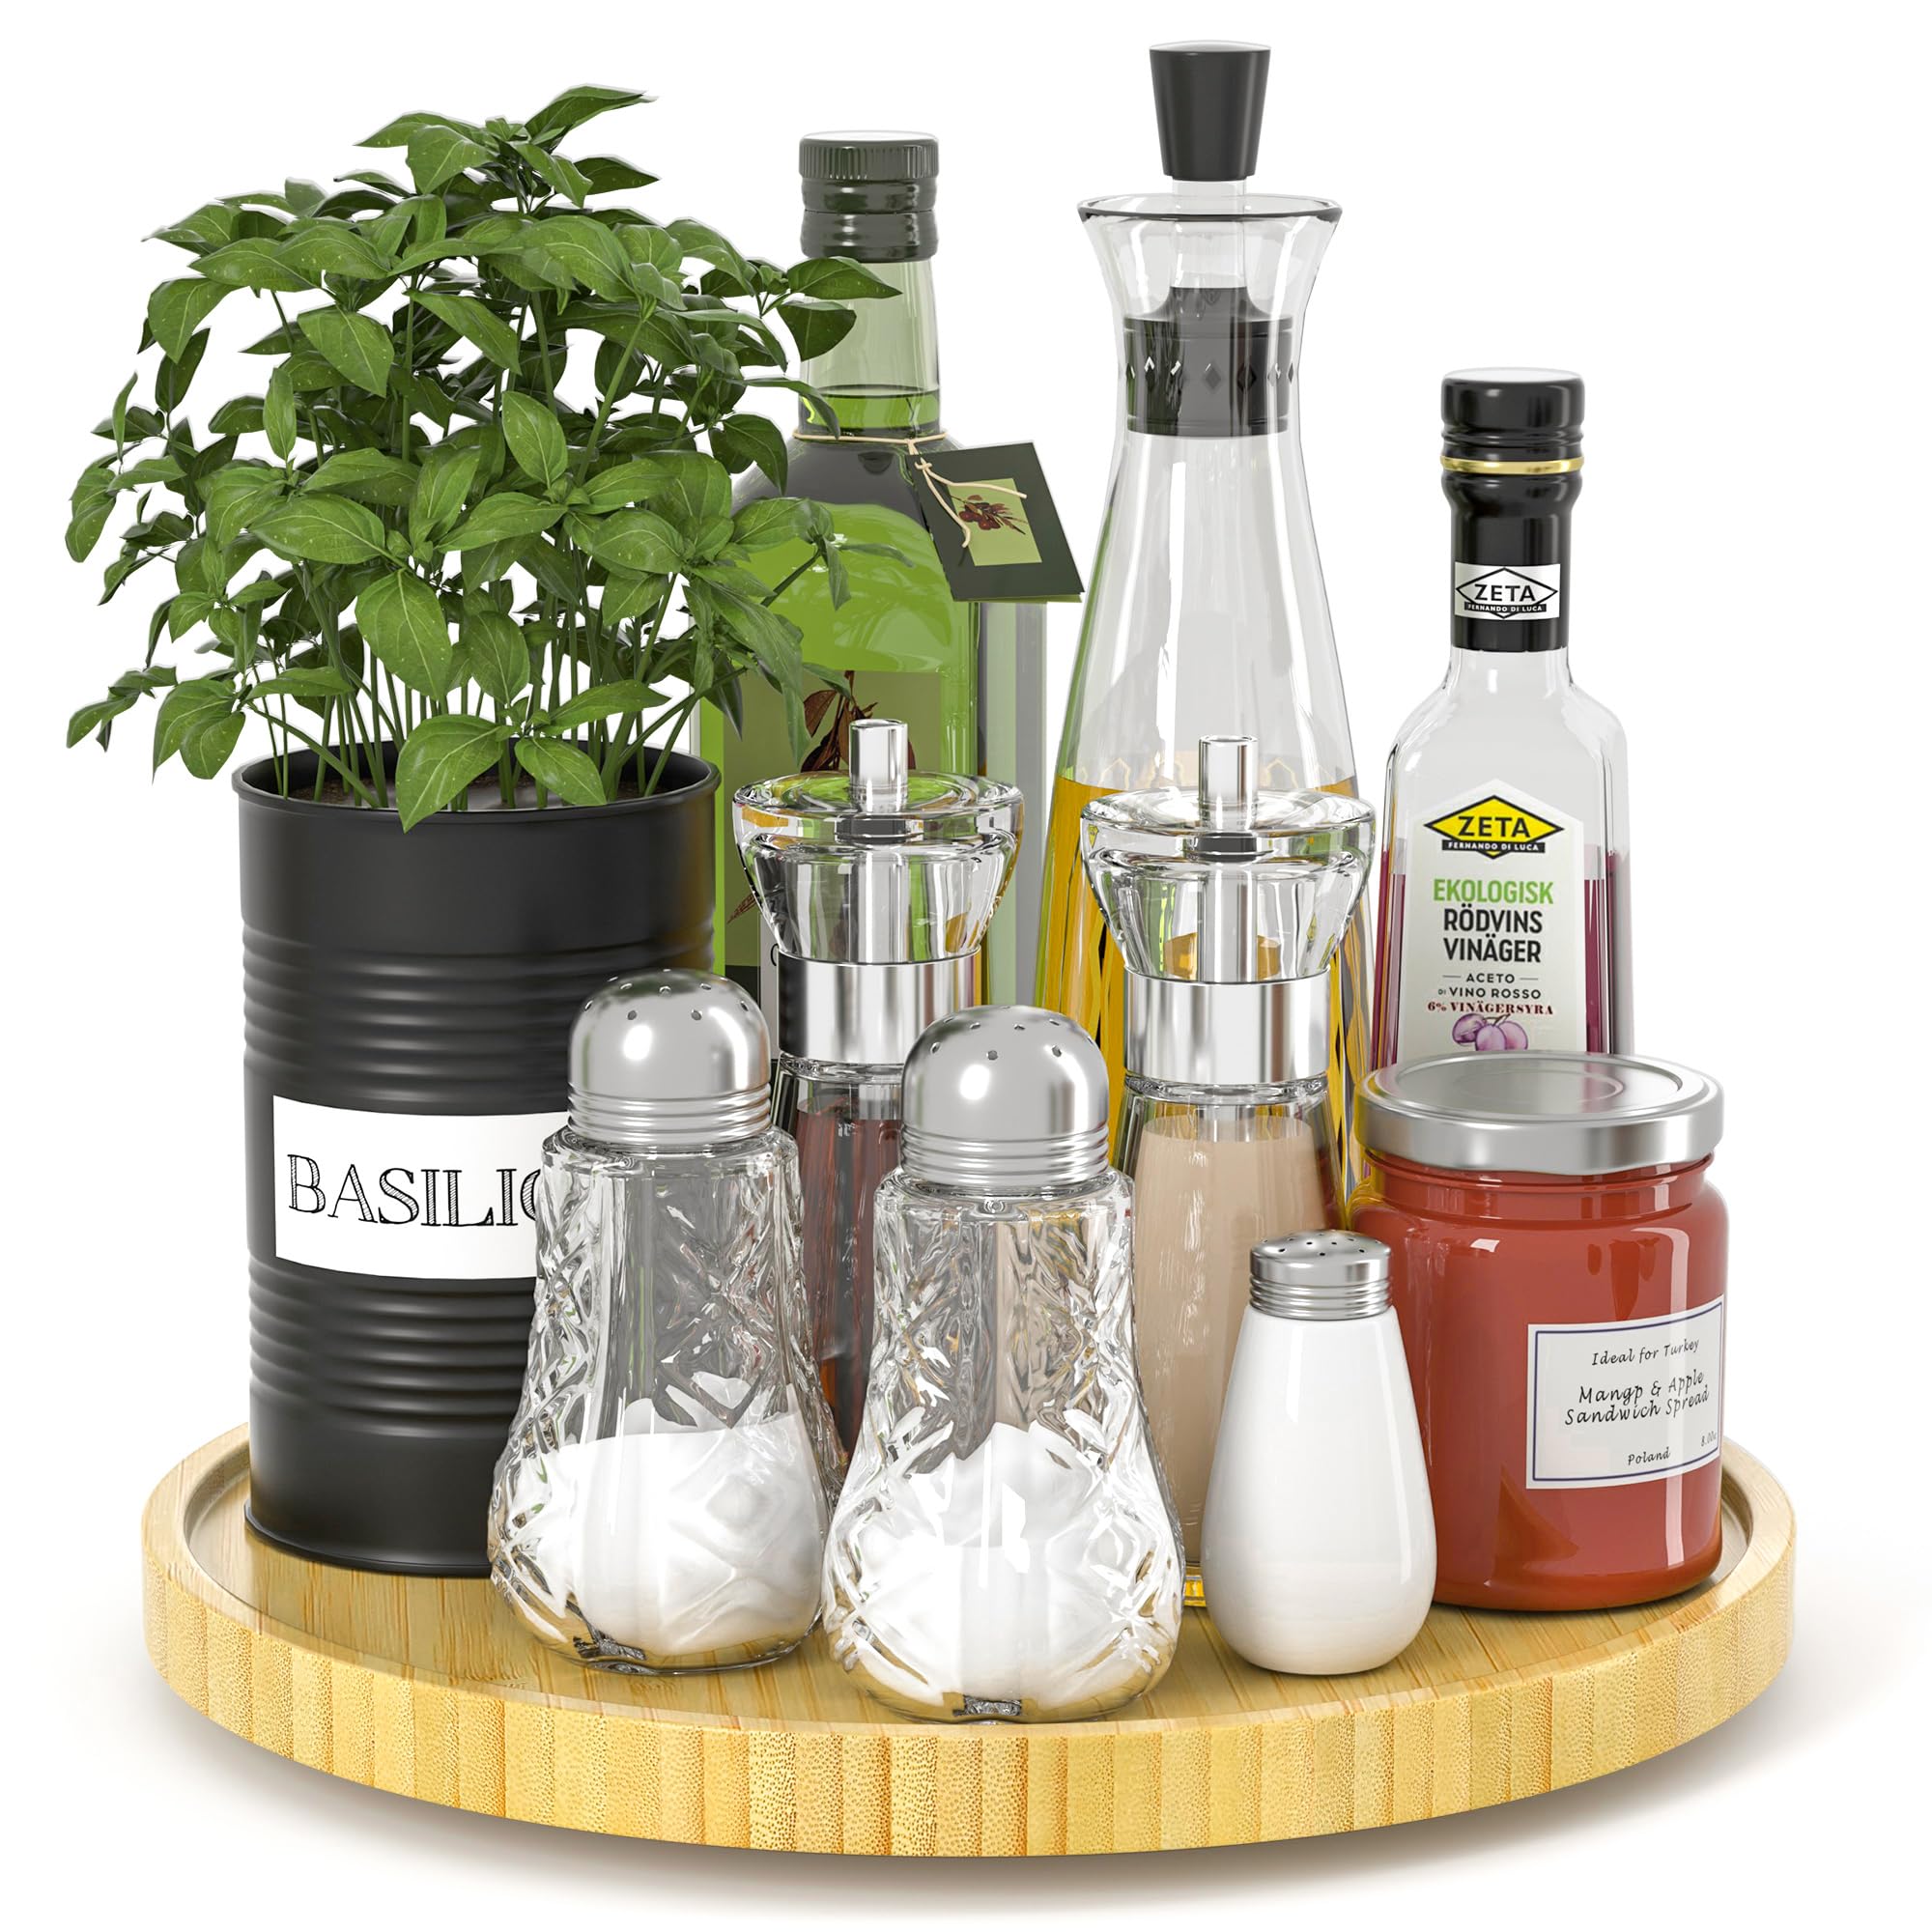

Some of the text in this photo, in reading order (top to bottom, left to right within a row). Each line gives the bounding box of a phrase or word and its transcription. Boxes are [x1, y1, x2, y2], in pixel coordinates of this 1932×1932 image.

[1474, 583, 1536, 602] ZETA
[1468, 604, 1508, 612] FERNANDO
[1458, 815, 1530, 838] ZETA
[1448, 841, 1498, 850] FERNANDO
[1433, 878, 1554, 904] EKOLOGISK
[1443, 903, 1543, 934] RÖDVINS
[1443, 933, 1542, 963] VINÄGER
[1465, 973, 1516, 984] ACETO
[1449, 986, 1487, 998] VINO
[1491, 988, 1542, 1000] ROSSO
[1427, 1000, 1554, 1014] 6% VINÄGERSYRA
[1591, 1338, 1700, 1366] Ideal for Turkey
[1650, 1380, 1662, 1398] &
[1667, 1368, 1705, 1397] Apple
[1564, 1383, 1710, 1426] Sandwich Spread
[1627, 1446, 1671, 1466] Poland
